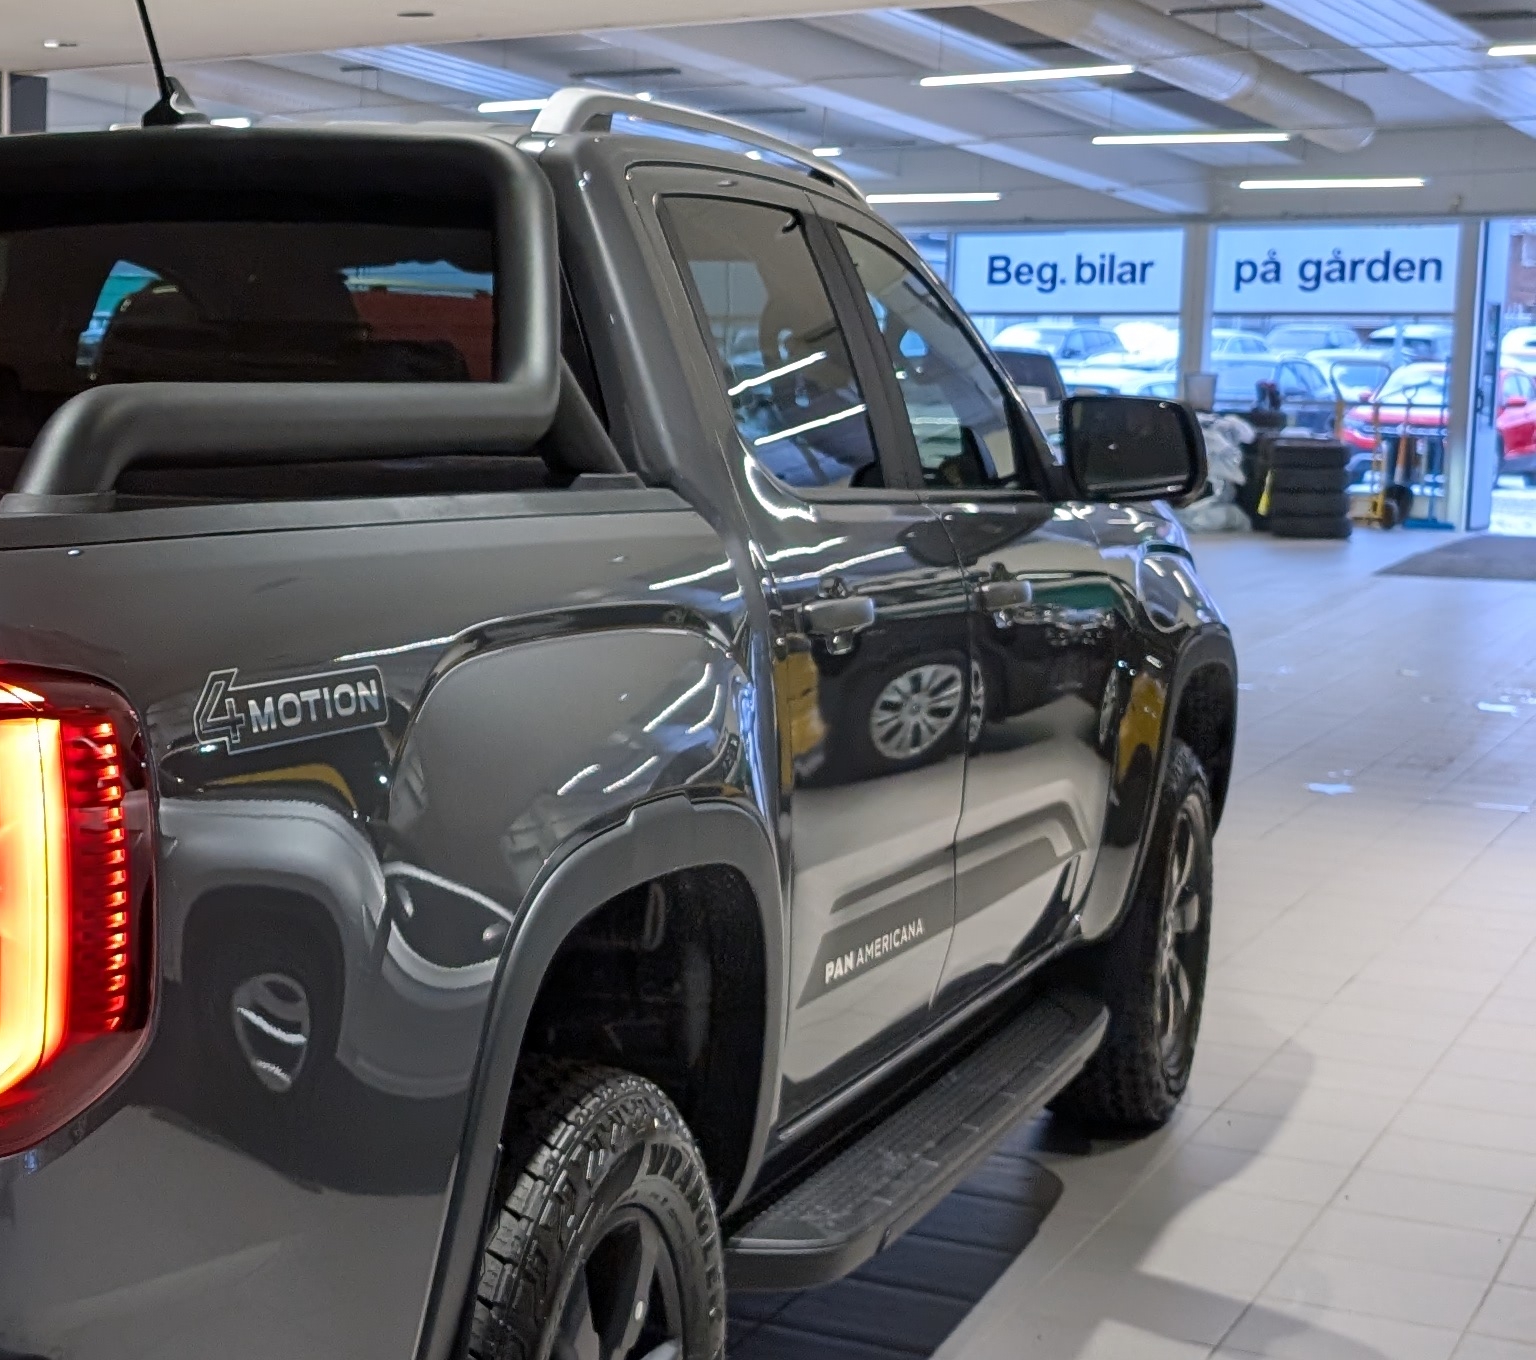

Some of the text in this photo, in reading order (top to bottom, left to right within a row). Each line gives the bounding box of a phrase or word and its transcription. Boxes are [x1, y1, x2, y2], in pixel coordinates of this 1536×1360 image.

[986, 253, 1155, 293] Beg. bilar
[1233, 248, 1443, 292] på gården
[199, 678, 380, 744] 4MOTION
